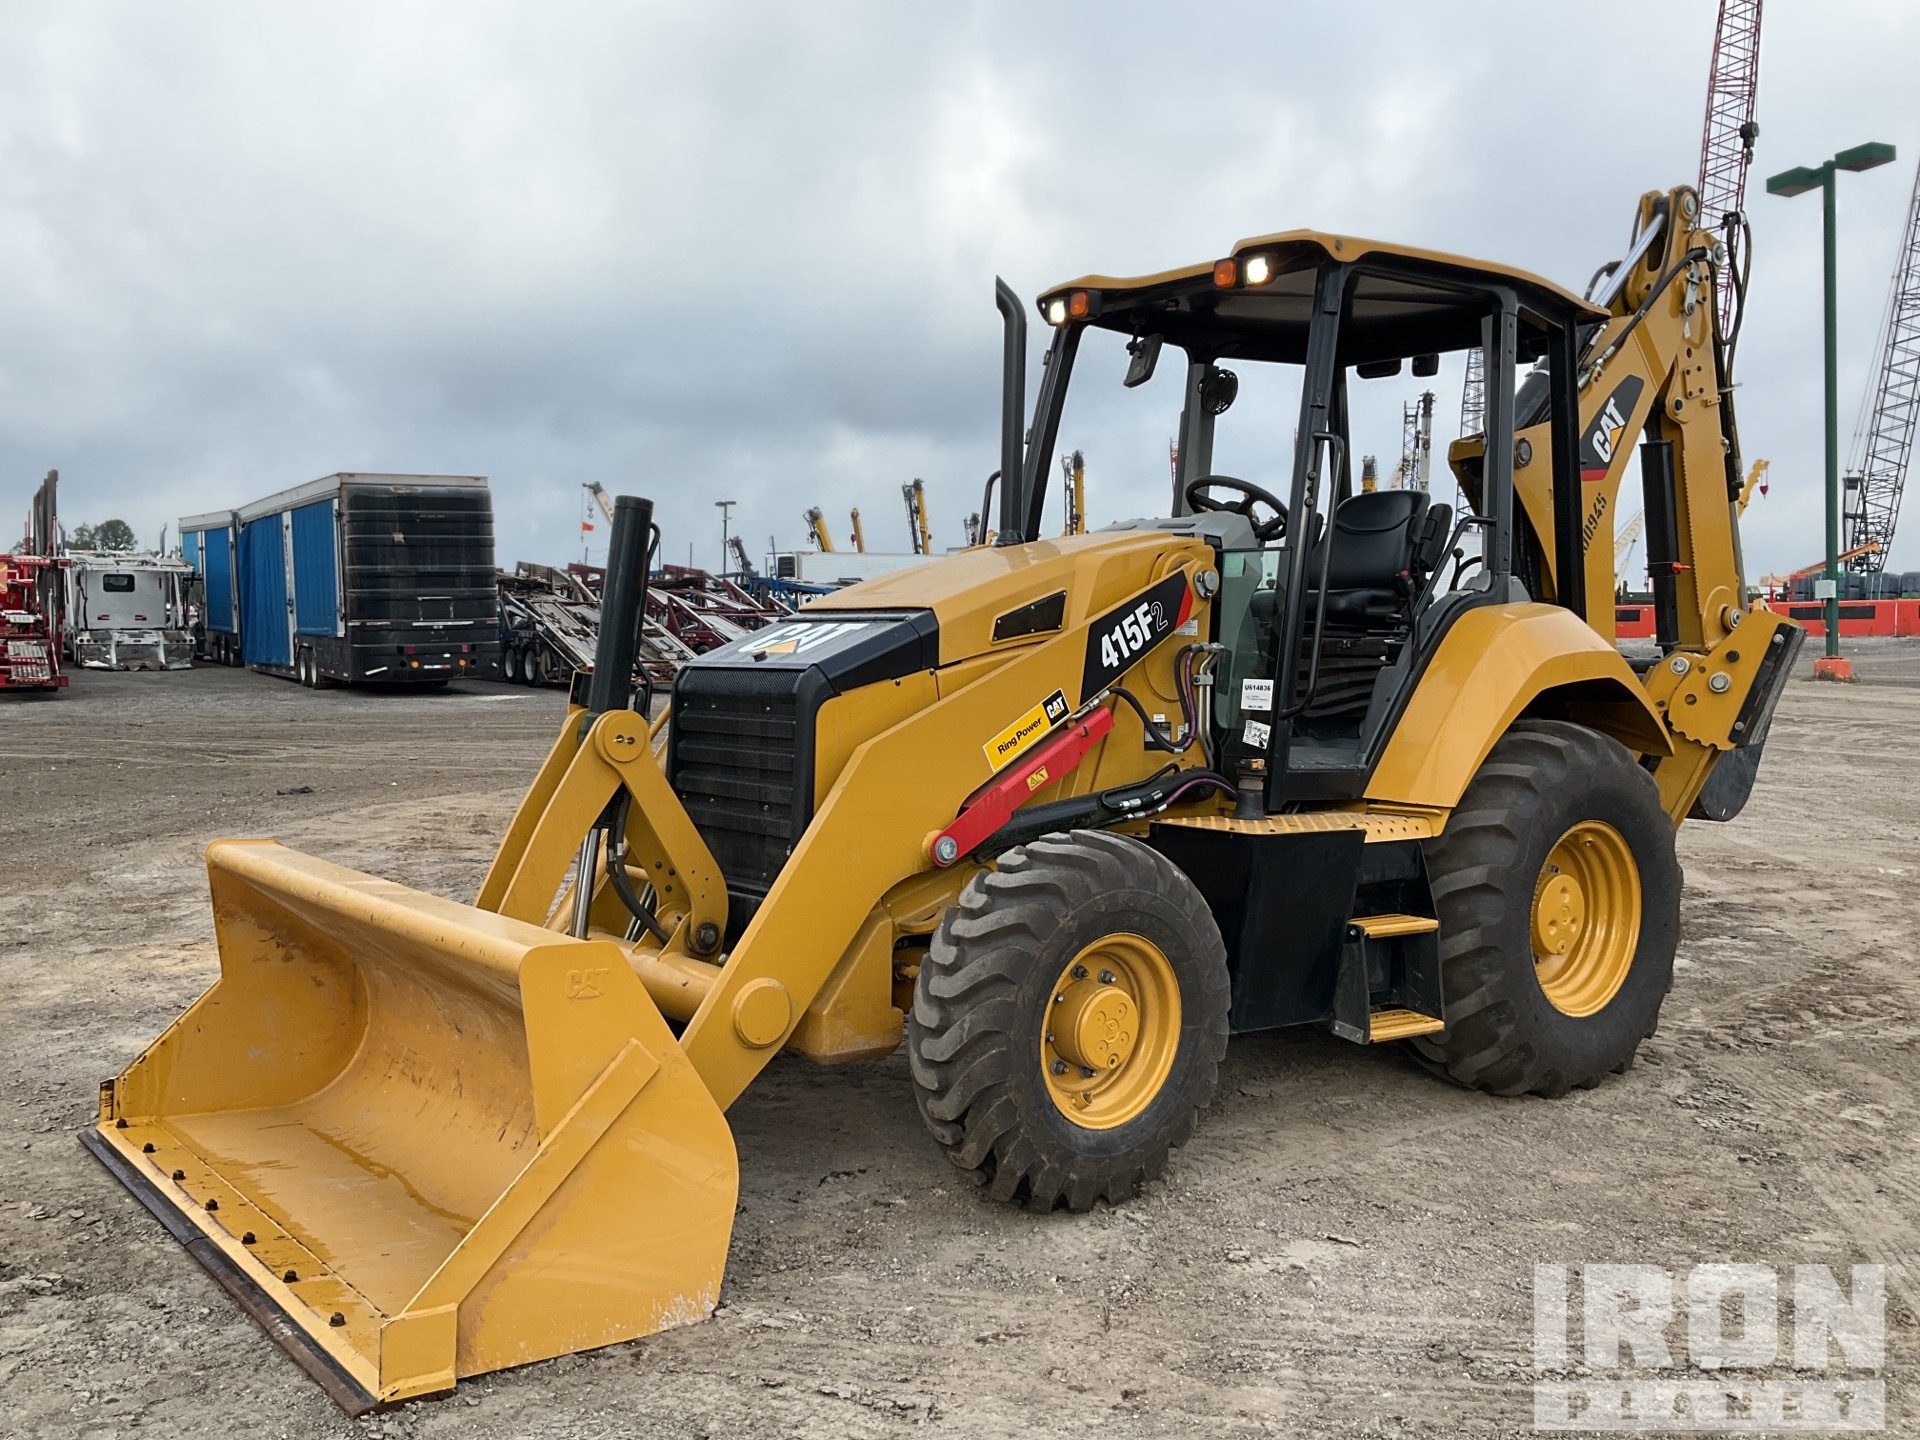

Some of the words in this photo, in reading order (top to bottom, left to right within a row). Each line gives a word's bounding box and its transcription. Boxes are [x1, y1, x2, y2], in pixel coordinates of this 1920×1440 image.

[1592, 396, 1626, 463] CAT
[738, 623, 870, 653] CAT
[1101, 601, 1168, 668] 415F2
[1046, 696, 1065, 719] CAT
[997, 736, 1018, 755] Ring
[1015, 716, 1042, 741] Power
